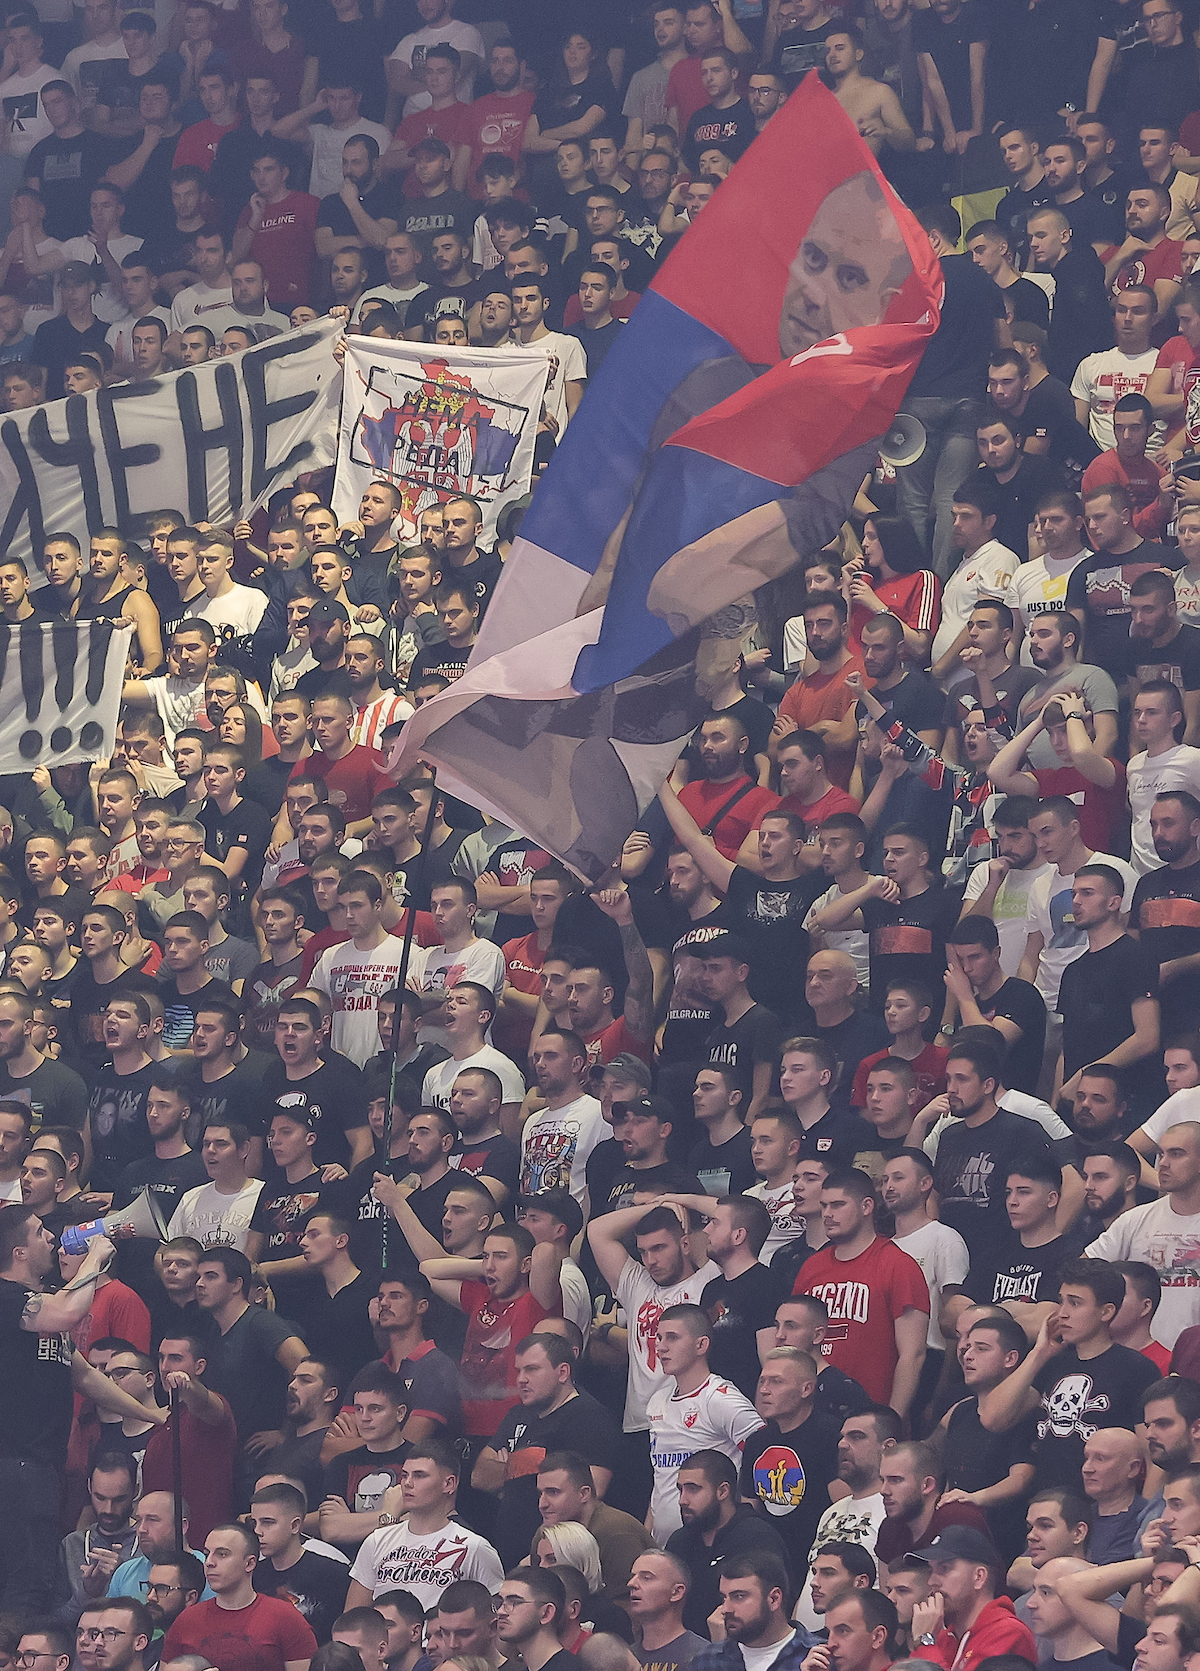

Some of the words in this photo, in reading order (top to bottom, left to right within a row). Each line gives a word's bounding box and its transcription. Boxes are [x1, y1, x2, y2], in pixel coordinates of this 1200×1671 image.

[1027, 602, 1047, 613] JUST
[1050, 601, 1063, 611] DO
[667, 1009, 711, 1020] BELGRADE
[804, 1281, 870, 1324] EGEND
